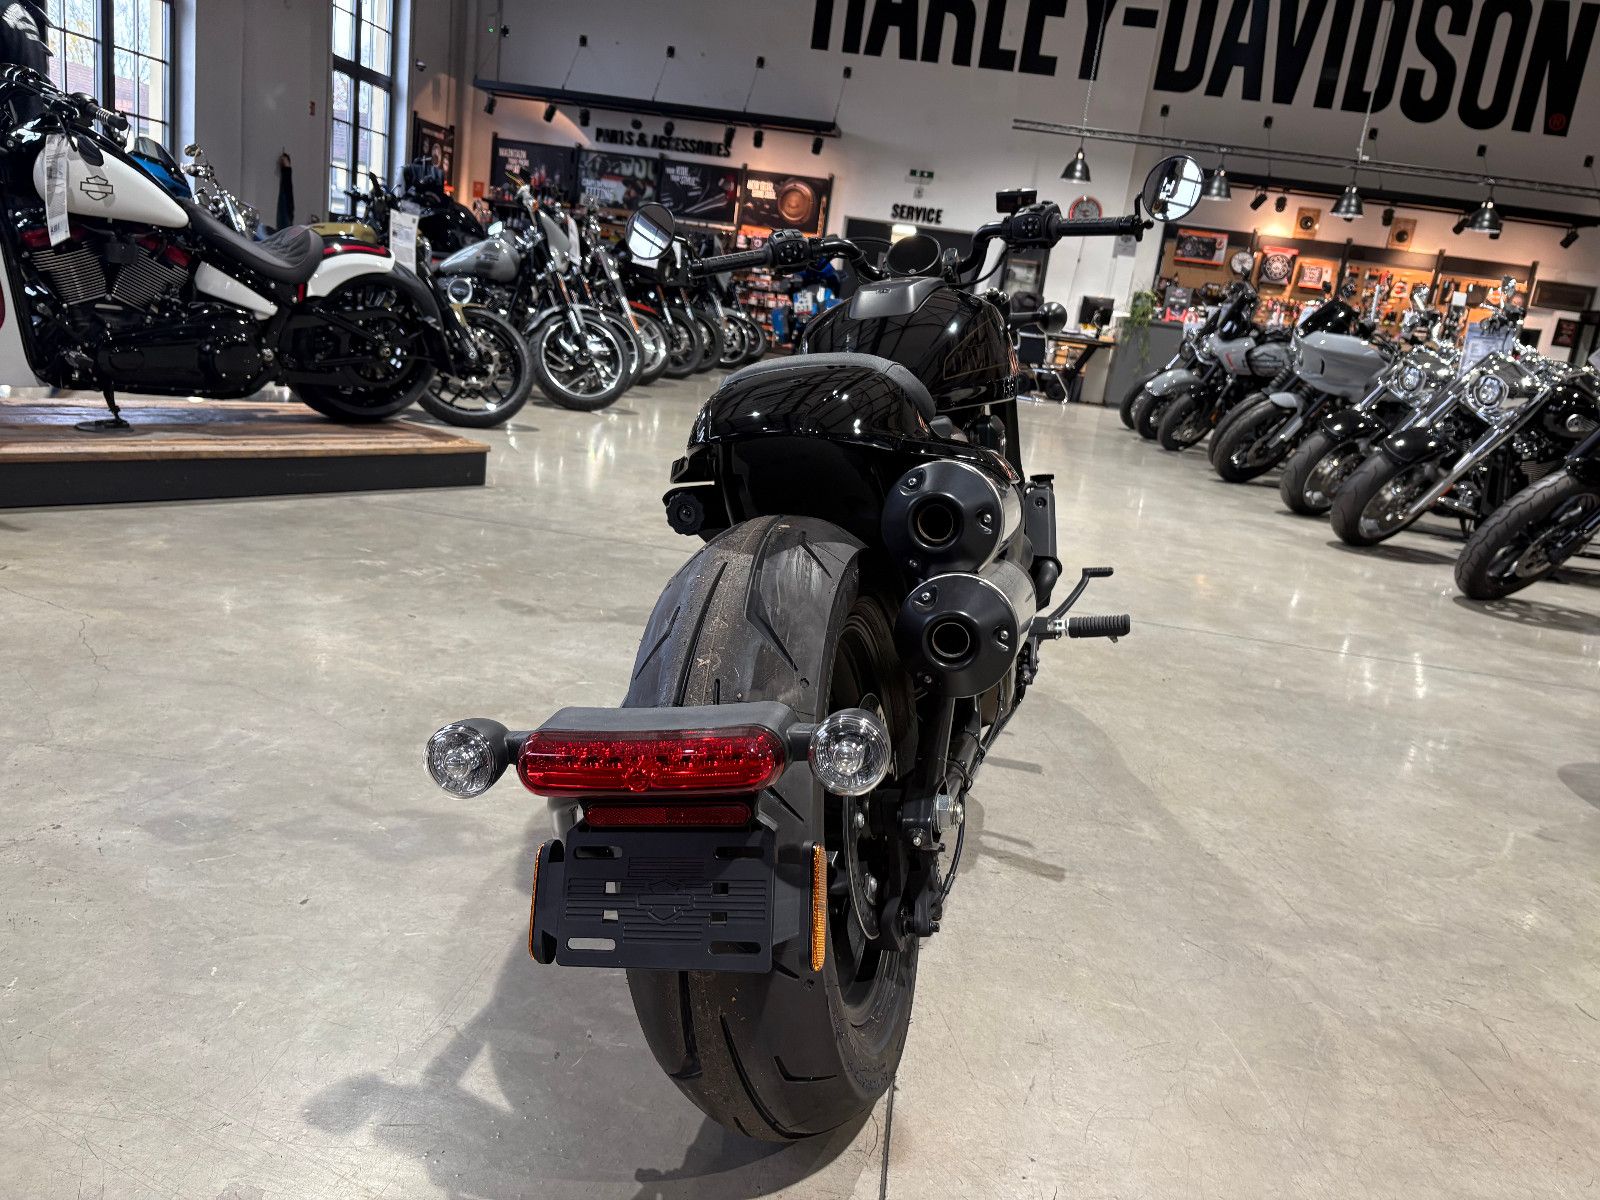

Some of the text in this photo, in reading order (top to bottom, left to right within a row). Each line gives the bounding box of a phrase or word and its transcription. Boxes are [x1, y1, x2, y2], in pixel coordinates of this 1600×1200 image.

[595, 127, 732, 158] PARTS & ACCESSORIES
[891, 203, 943, 224] SERVICE
